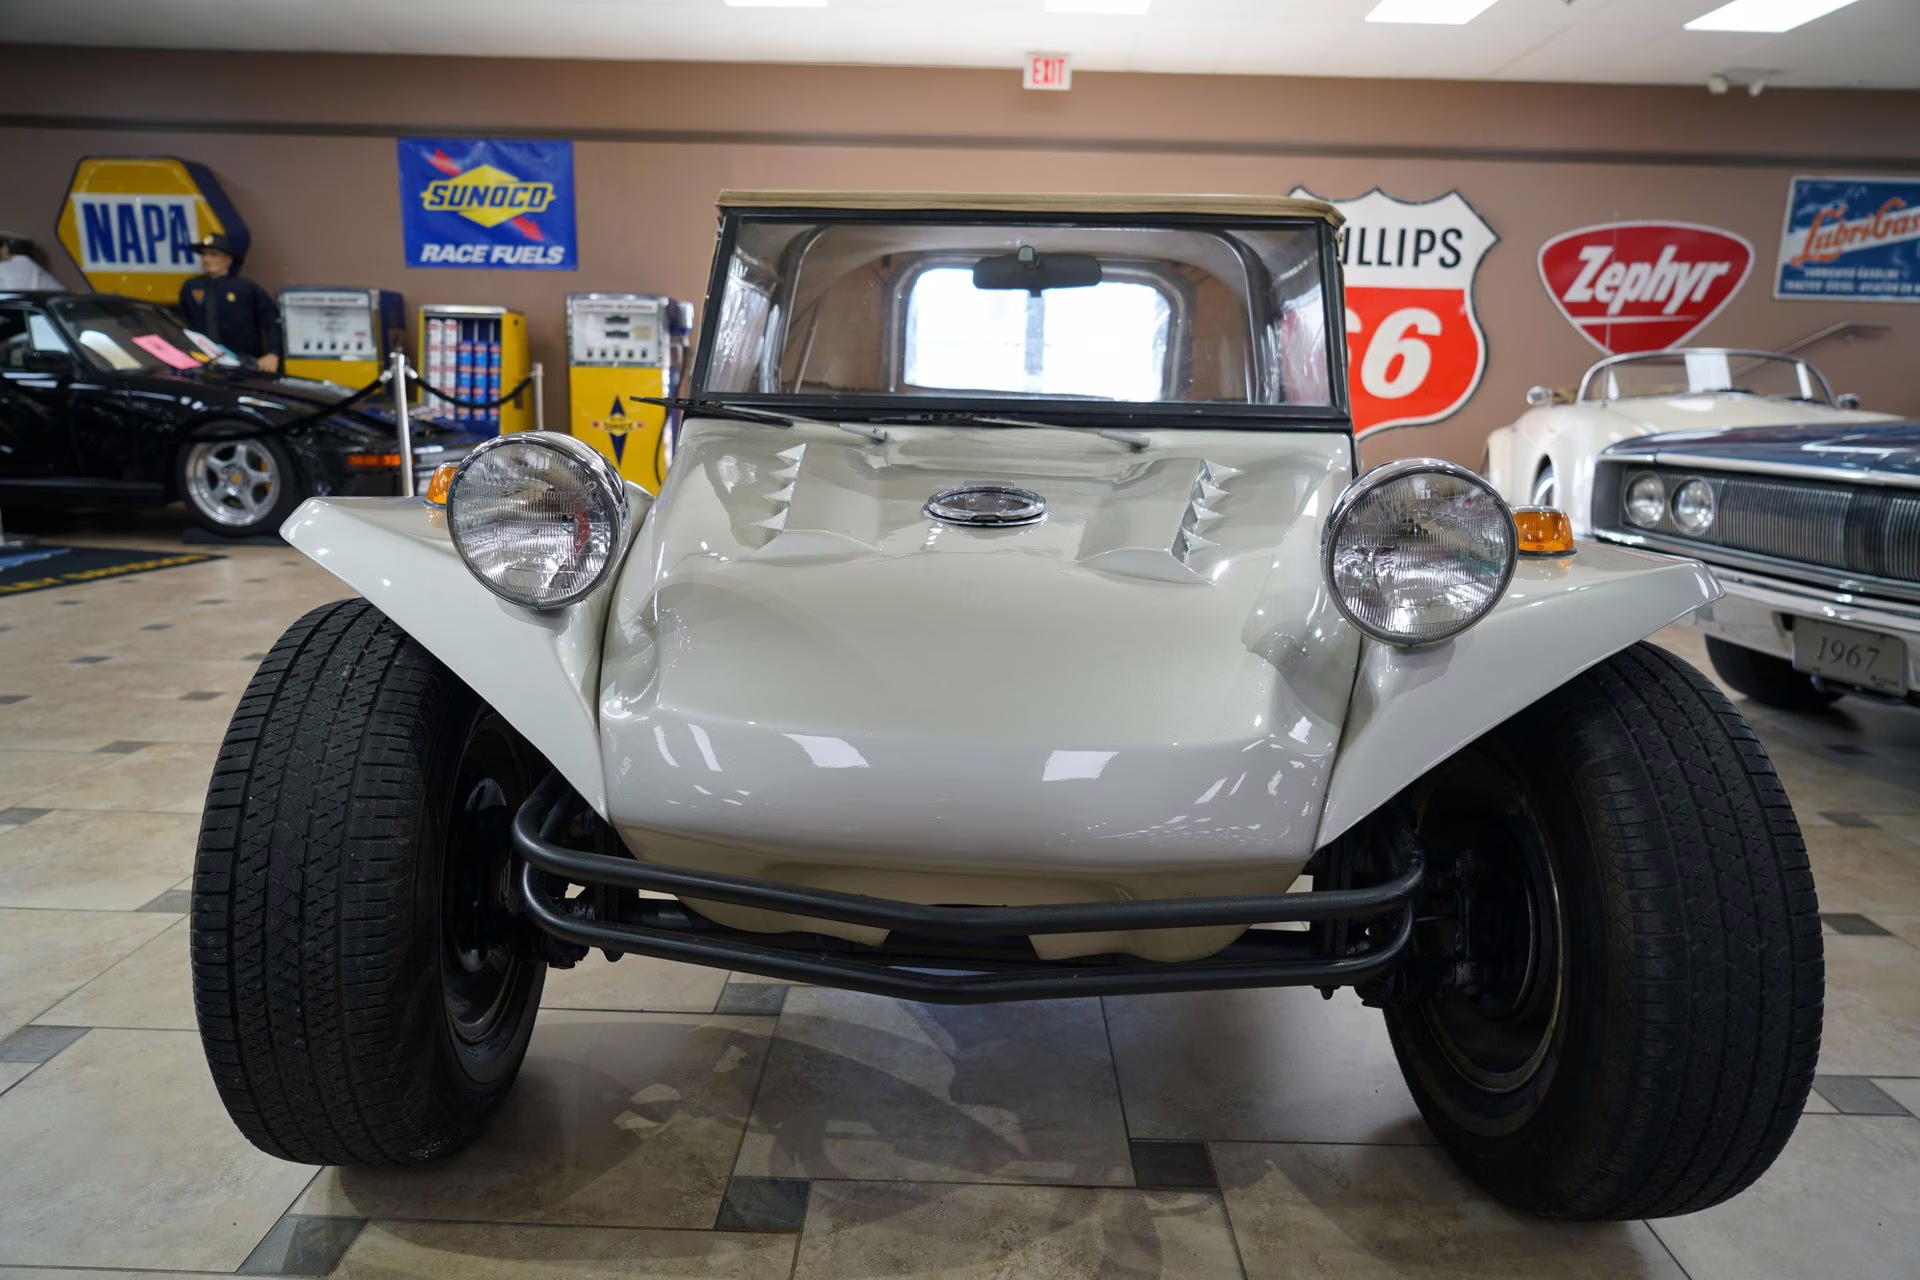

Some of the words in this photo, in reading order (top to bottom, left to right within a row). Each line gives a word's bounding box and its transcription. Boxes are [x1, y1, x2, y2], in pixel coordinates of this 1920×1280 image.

[1032, 57, 1065, 85] EXIT
[427, 184, 549, 208] SUNOCO
[82, 202, 195, 265] NAPA
[1342, 226, 1463, 269] ILLIPS
[420, 243, 490, 264] RACE
[490, 245, 566, 265] FUELS
[1562, 245, 1732, 316] Zephyr
[1817, 637, 1880, 672] 1967
